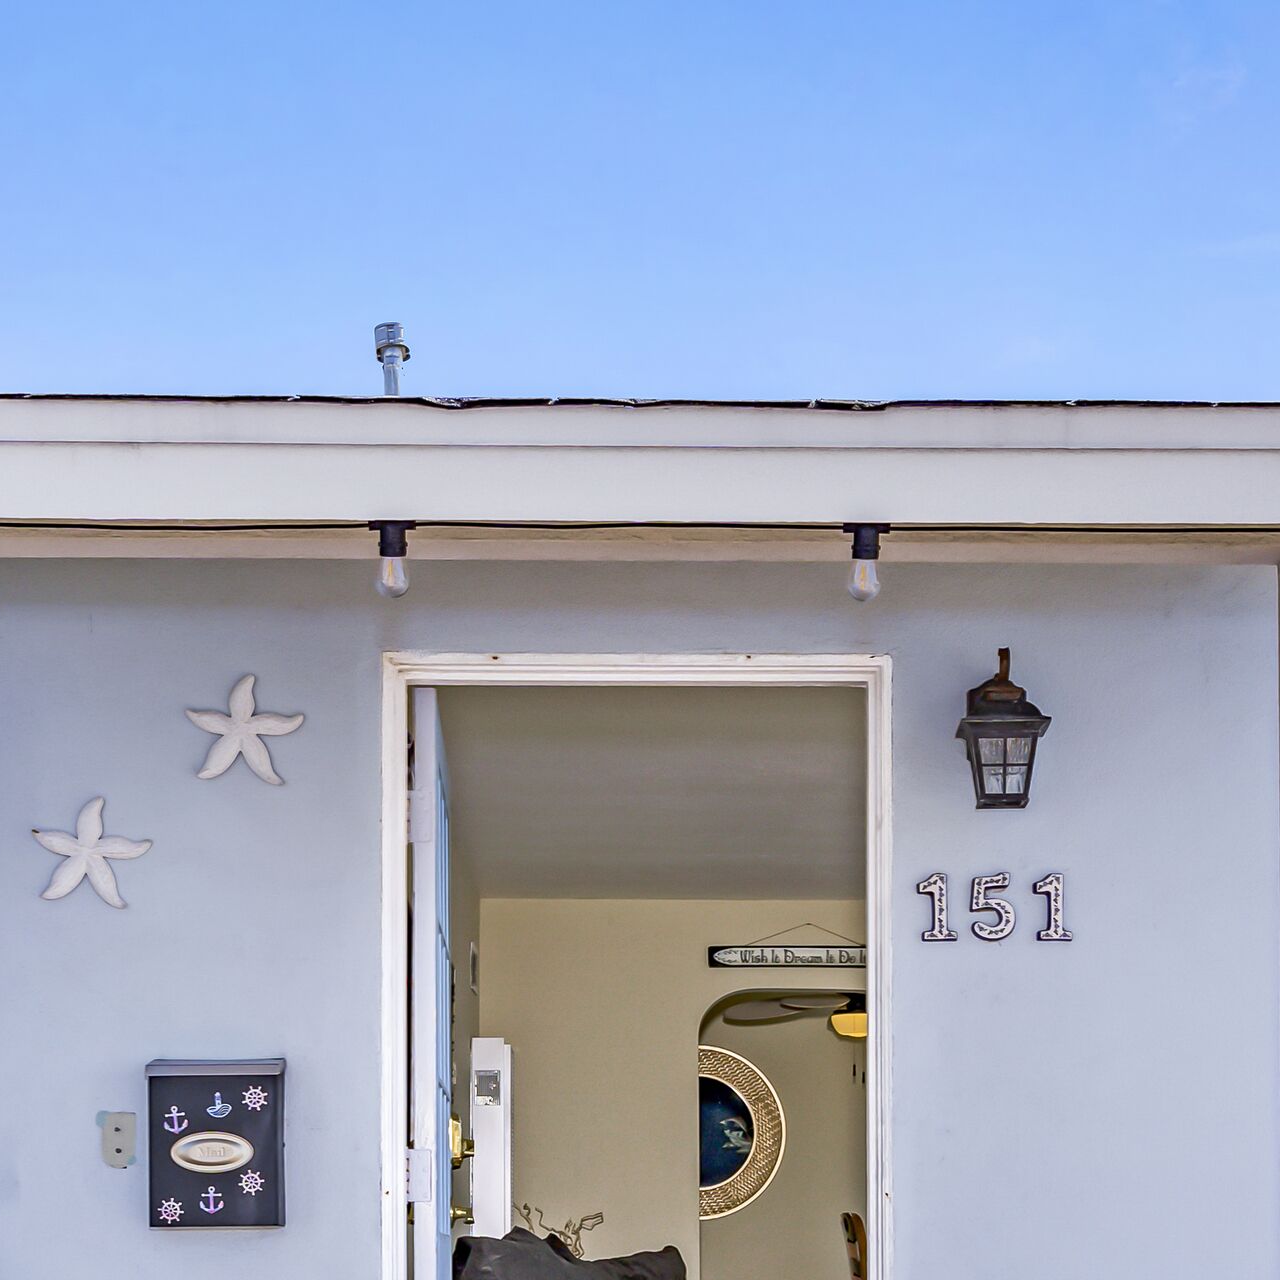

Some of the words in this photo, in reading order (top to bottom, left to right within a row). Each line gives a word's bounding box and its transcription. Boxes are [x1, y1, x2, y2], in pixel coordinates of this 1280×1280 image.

[916, 872, 1073, 942] 151
[739, 949, 768, 964] Wish
[771, 949, 780, 964] It
[784, 949, 823, 964] Dream
[826, 949, 835, 964] It
[838, 949, 857, 964] Do
